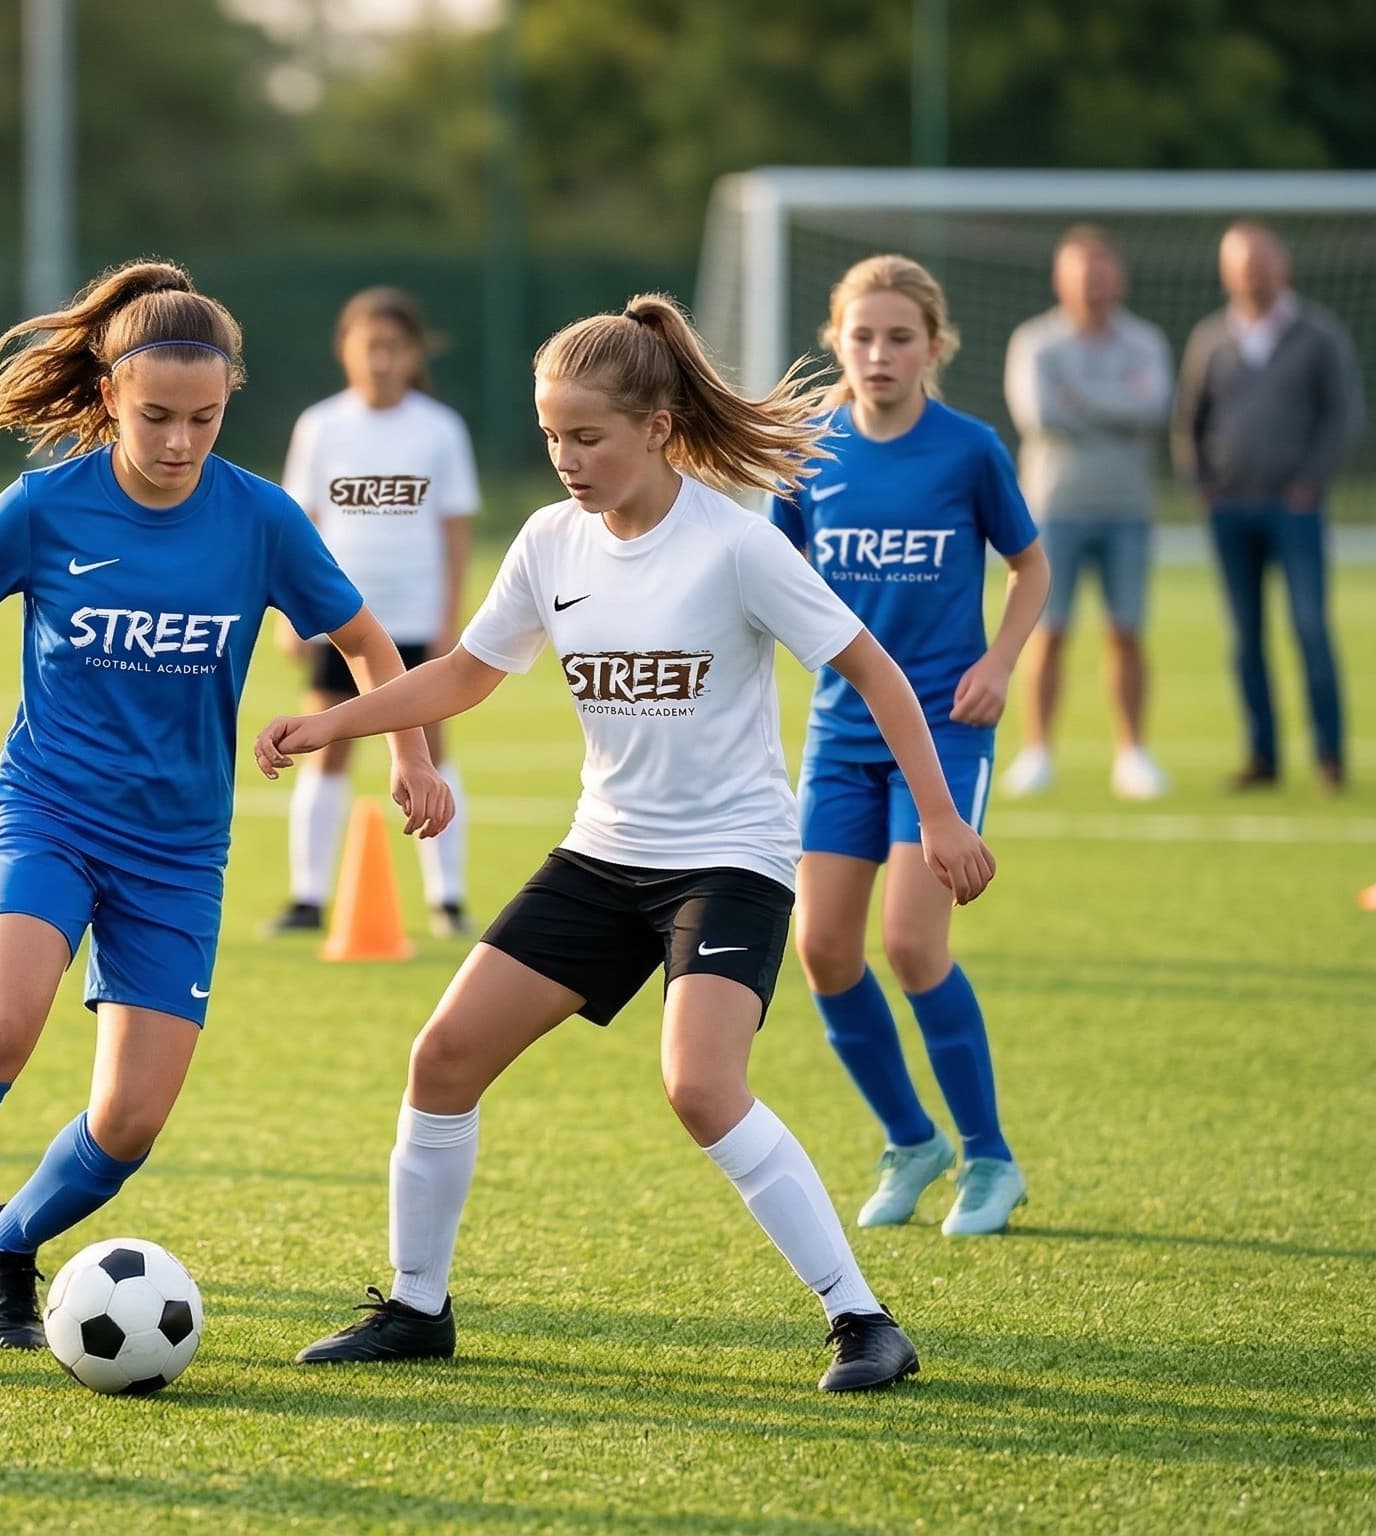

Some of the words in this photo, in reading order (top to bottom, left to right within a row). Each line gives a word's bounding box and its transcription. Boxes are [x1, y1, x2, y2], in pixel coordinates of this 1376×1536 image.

[333, 478, 430, 506] STREET
[814, 528, 956, 569] STREET
[831, 571, 882, 582] OOTBALL
[884, 572, 940, 583] ACADEMY
[69, 606, 240, 658] STREET
[85, 657, 151, 672] FOOTBALL
[157, 664, 218, 675] ACADEMY
[565, 655, 714, 702] STREET
[582, 704, 637, 716] FOOTBALL
[640, 707, 695, 717] ACADEMY
